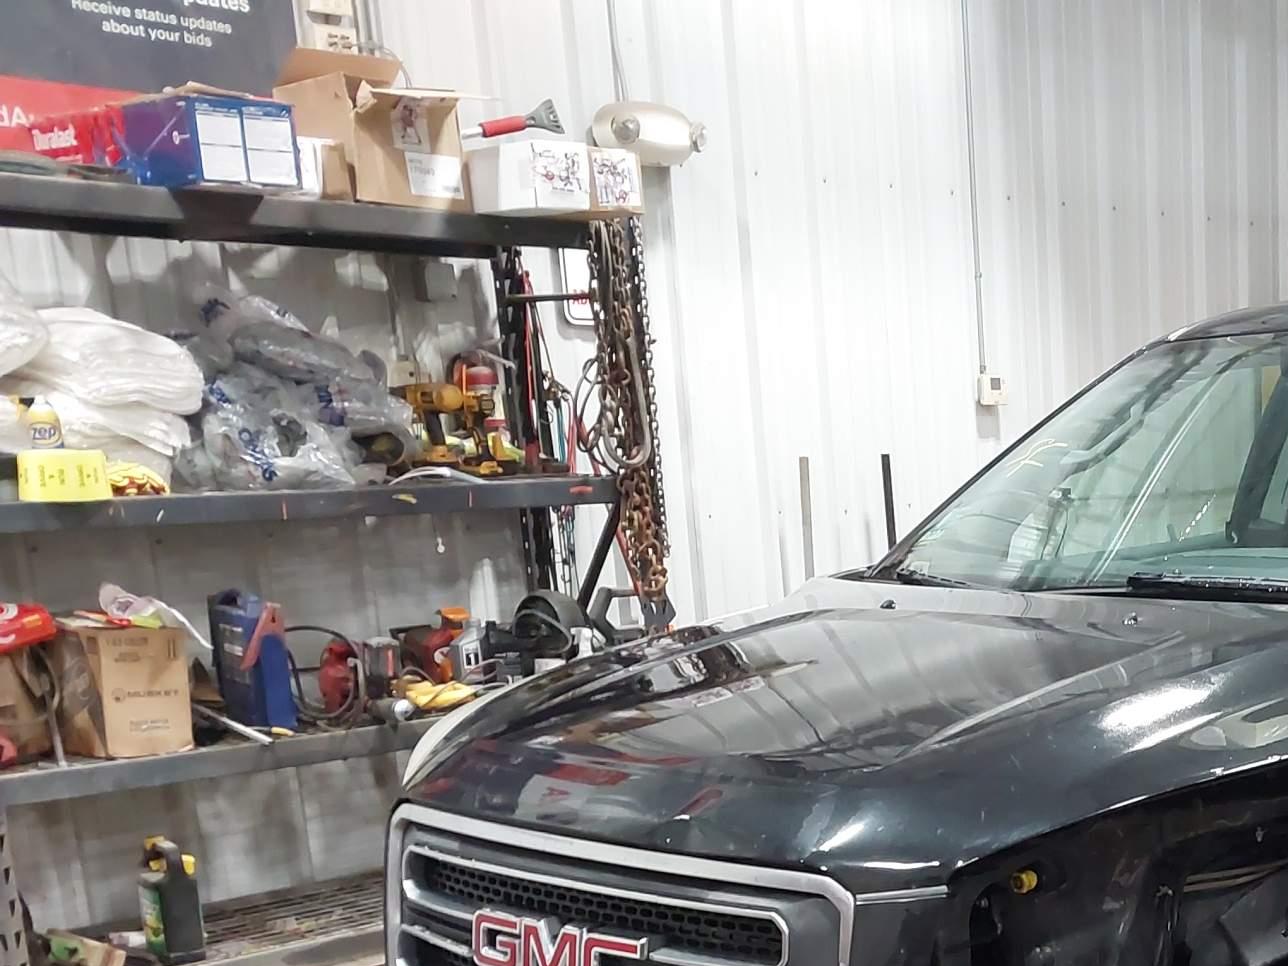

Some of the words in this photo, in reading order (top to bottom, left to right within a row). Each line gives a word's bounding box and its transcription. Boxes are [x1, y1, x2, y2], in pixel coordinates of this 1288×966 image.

[71, 0, 131, 19] Receive
[135, 8, 177, 25] status
[180, 15, 232, 34] updates
[184, 0, 251, 13] ates
[102, 20, 145, 38] about
[149, 27, 180, 42] your
[183, 30, 212, 47] bids
